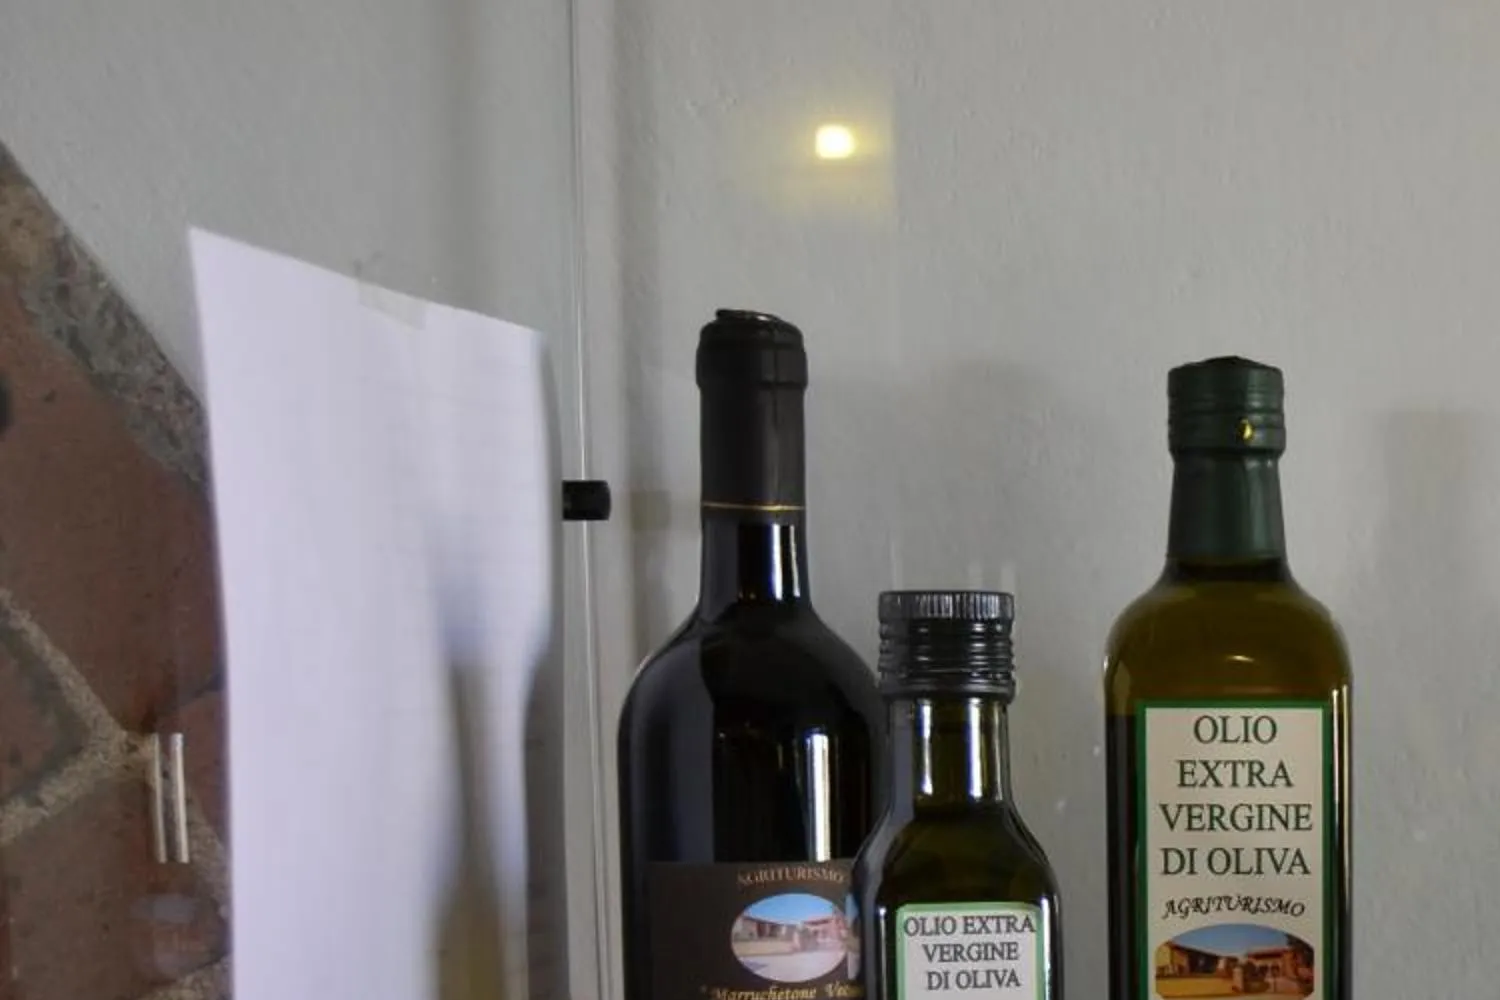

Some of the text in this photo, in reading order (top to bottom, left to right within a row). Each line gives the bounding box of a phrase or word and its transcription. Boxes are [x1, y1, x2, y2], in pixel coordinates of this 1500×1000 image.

[1194, 715, 1278, 744] OLIO
[1176, 760, 1294, 788] EXTRA
[1159, 804, 1313, 832] VERGINE
[1160, 848, 1311, 875] DI OLIVA
[1161, 895, 1306, 919] AGRITURISMO
[904, 915, 1036, 936] OLIO EXTRA
[922, 942, 1019, 963] VERGINE
[927, 969, 1021, 990] DI OLIVA
